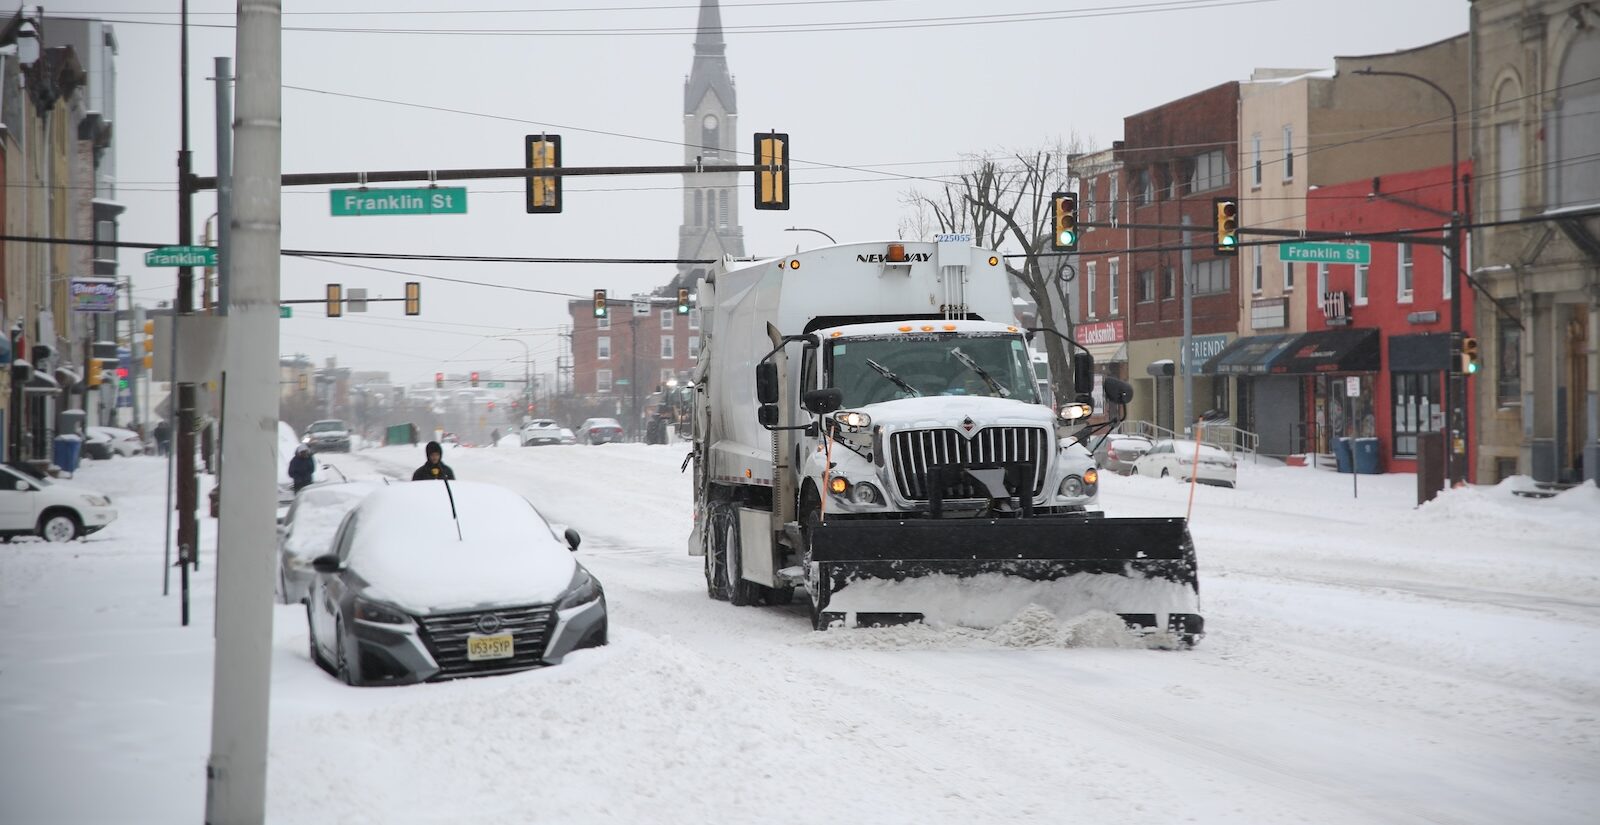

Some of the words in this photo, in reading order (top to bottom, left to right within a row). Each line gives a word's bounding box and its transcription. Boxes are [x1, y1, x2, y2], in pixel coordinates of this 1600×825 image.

[345, 195, 424, 210] Franklin
[432, 194, 453, 209] St
[938, 234, 971, 243] 225055
[146, 252, 206, 265] Franklin
[1288, 246, 1340, 259] Franklin
[1346, 248, 1360, 260] St
[1084, 322, 1116, 344] Locksmith
